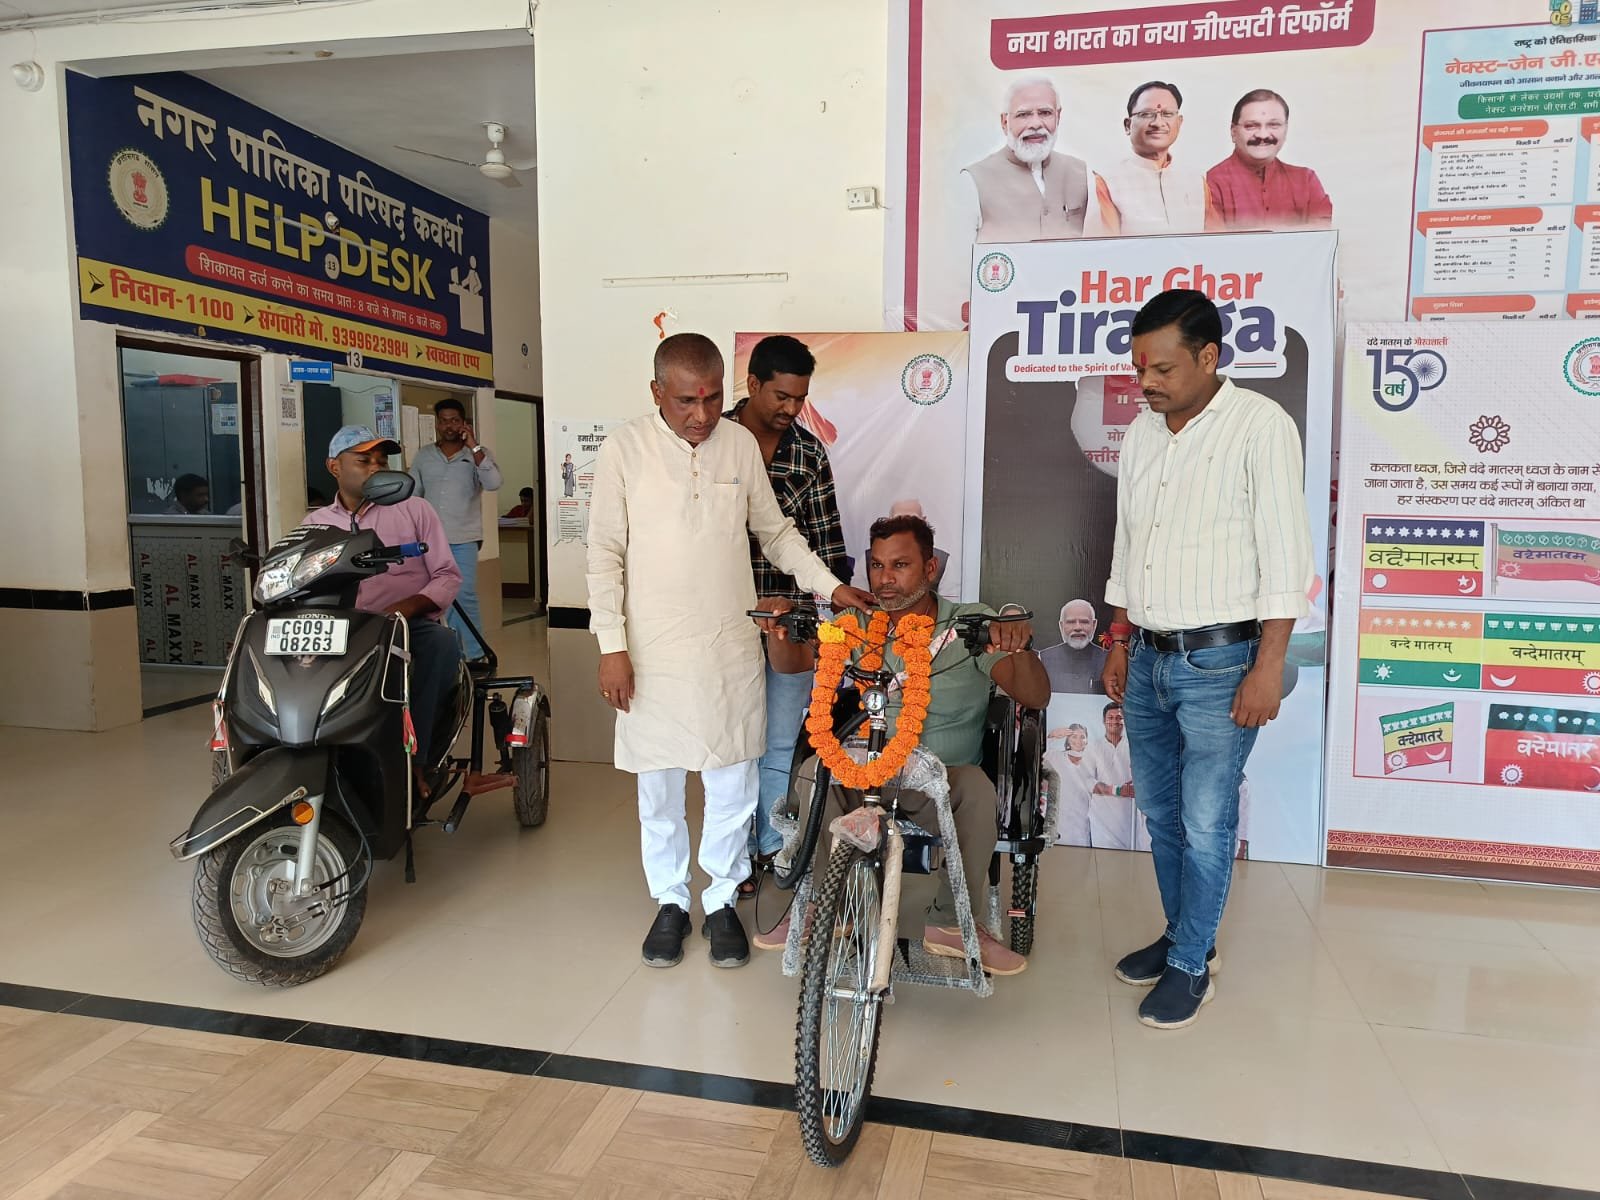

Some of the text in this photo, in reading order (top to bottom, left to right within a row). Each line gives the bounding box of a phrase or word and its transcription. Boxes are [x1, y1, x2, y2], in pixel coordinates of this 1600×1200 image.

[1006, 0, 1353, 54] नया भारत का नया जीएसटी रिफॉर्म
[1534, 36, 1546, 46] को
[1549, 34, 1597, 45] ऐतिहासिक
[134, 85, 464, 257] नगर पालिका परिषद कवर्धा
[201, 176, 435, 299] HELP DESK
[198, 252, 246, 282] शिकायत
[249, 269, 268, 287] दर्ज
[271, 275, 294, 294] करने
[296, 280, 309, 297] का
[312, 285, 334, 303] समय
[358, 301, 364, 312] 8
[366, 300, 380, 316] बजे
[382, 304, 390, 319] से
[392, 307, 407, 323] शाम
[409, 313, 415, 325] 6
[417, 312, 428, 328] बजे
[429, 318, 442, 331] तक
[1081, 264, 1264, 304] Har Ghar
[258, 304, 409, 358] संगवारी मो. 9399623984
[1367, 336, 1378, 346] वंदे
[1380, 338, 1403, 347] मातरम्
[348, 351, 361, 368] 13
[426, 345, 461, 366] स्वच्छता
[1014, 363, 1056, 373] Dedicated
[1058, 364, 1067, 372] to
[1069, 363, 1082, 372] the
[1085, 362, 1108, 374] Spirit
[1110, 362, 1119, 371] of
[1366, 349, 1447, 412] 150
[1384, 378, 1407, 396] वर्ष
[1414, 463, 1441, 475] ध्वज,
[1444, 461, 1467, 474] जिसे
[1469, 461, 1485, 474] वंदे
[1488, 464, 1524, 477] मातरम्
[1526, 465, 1551, 475] ध्वज
[1553, 462, 1566, 475] के
[1568, 466, 1589, 475] नाम
[1364, 476, 1597, 493] जाना जाता है, उस समय कई रूपों में बनाया गया,
[1397, 493, 1586, 509] हर संस्करण पर वंदे मातरम् अंकित था
[141, 553, 154, 608] AL MAXX
[187, 553, 201, 609] AL MAXX
[222, 576, 234, 610] MAXX
[165, 584, 182, 663] AL MAXX
[281, 620, 334, 635] CG09J
[145, 638, 156, 653] AL
[193, 641, 203, 656] AL
[1389, 637, 1453, 654] वन्दे मातरम्
[1509, 643, 1586, 666] वन्देमातरम्
